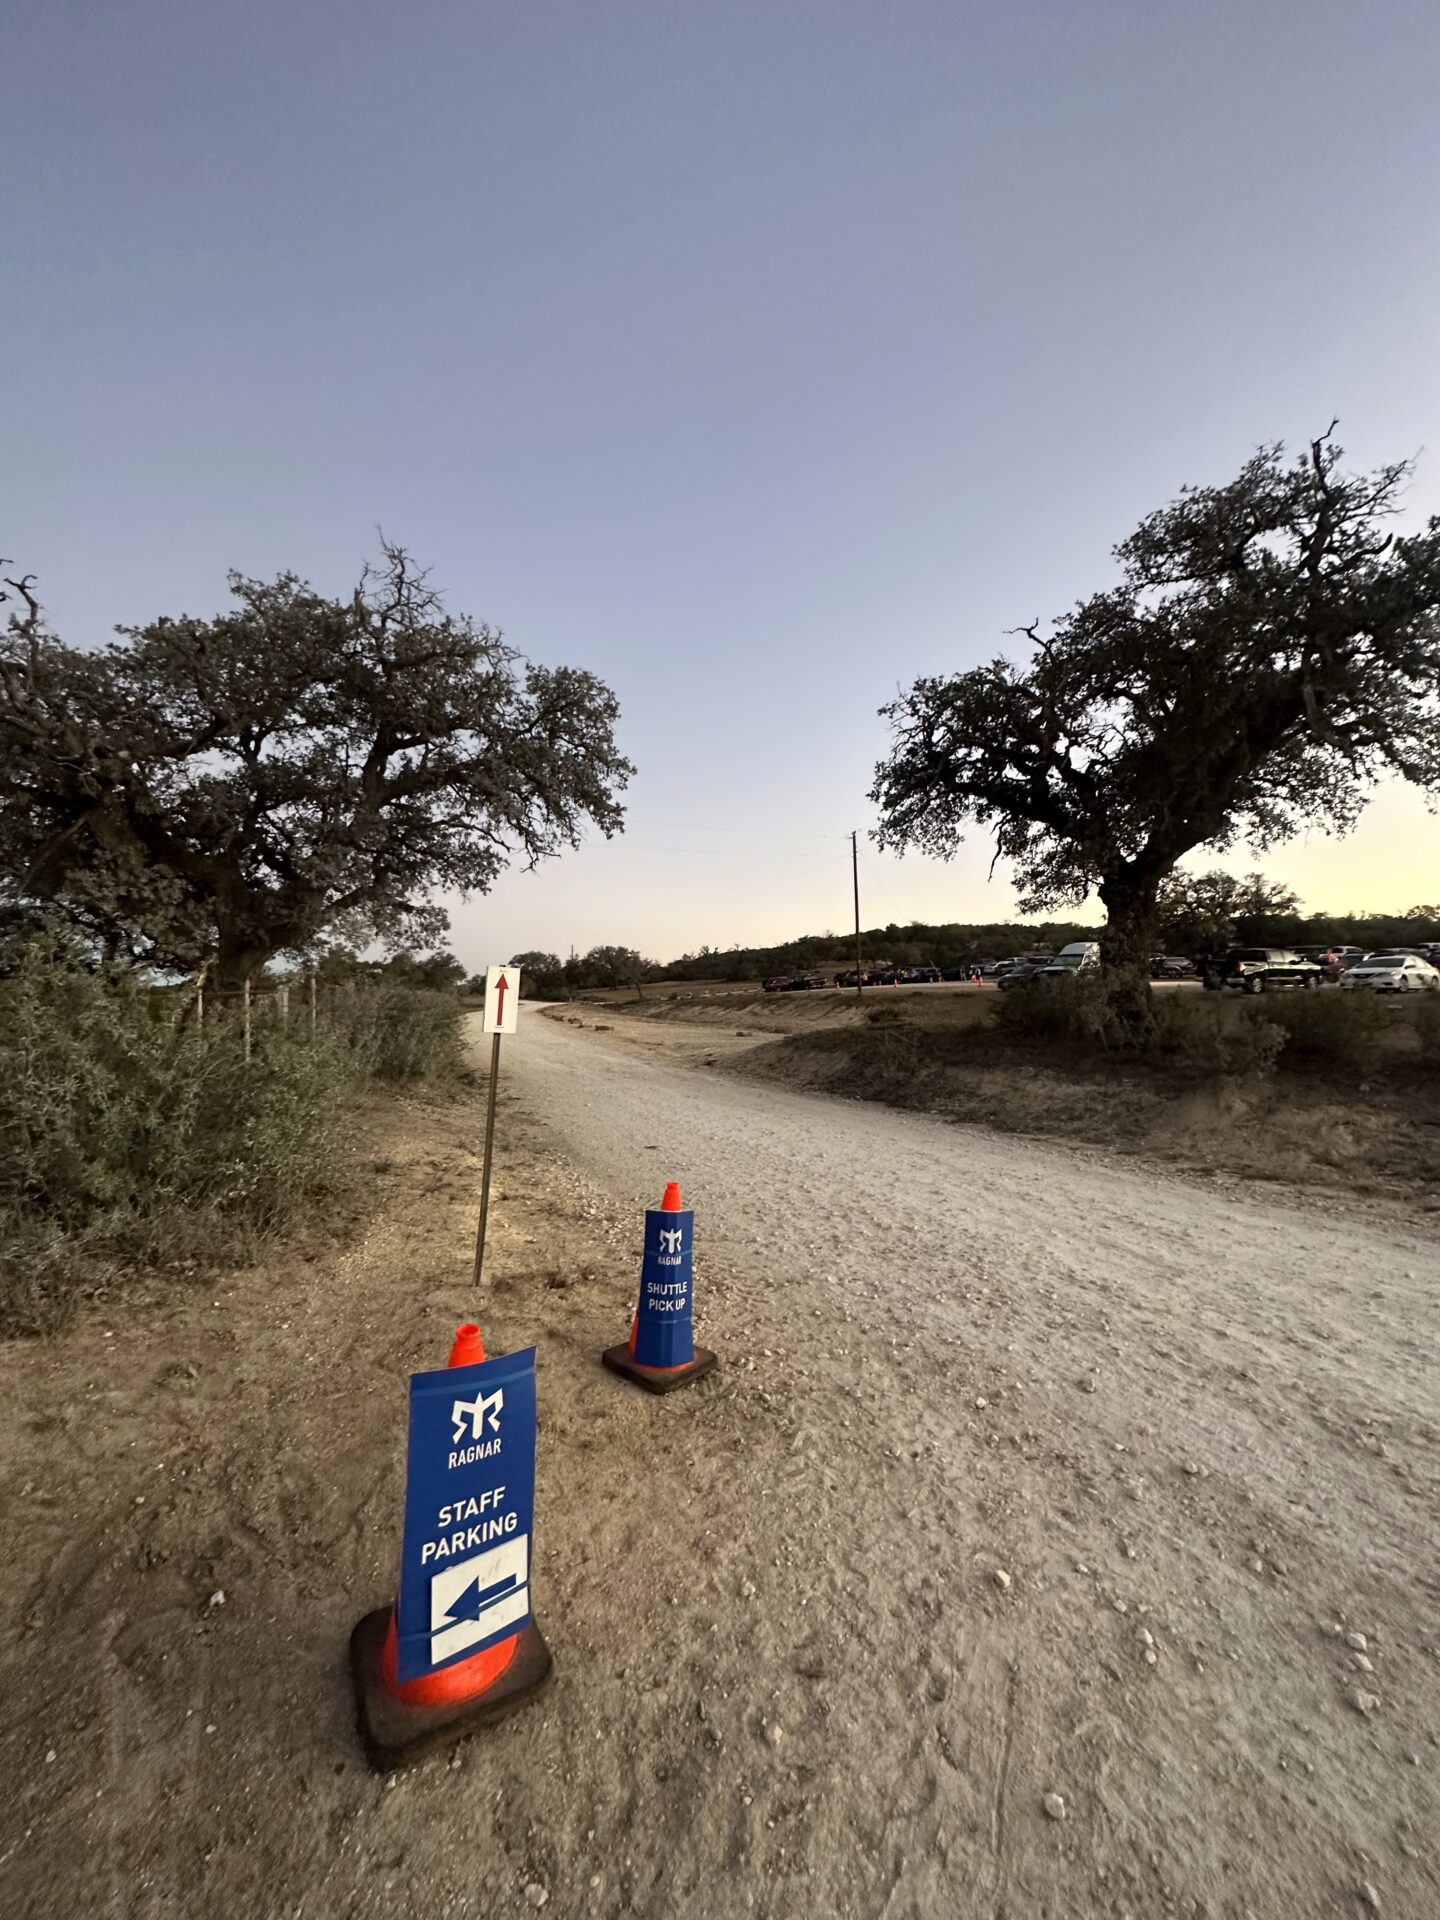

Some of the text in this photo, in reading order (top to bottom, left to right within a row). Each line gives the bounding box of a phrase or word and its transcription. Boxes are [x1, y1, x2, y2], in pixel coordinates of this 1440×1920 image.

[647, 1281, 688, 1295] SHUTTLE
[649, 1298, 685, 1312] PICK UP
[448, 1438, 502, 1469] RAGNAR
[438, 1486, 506, 1528] STAFF
[421, 1512, 518, 1565] PARKING
